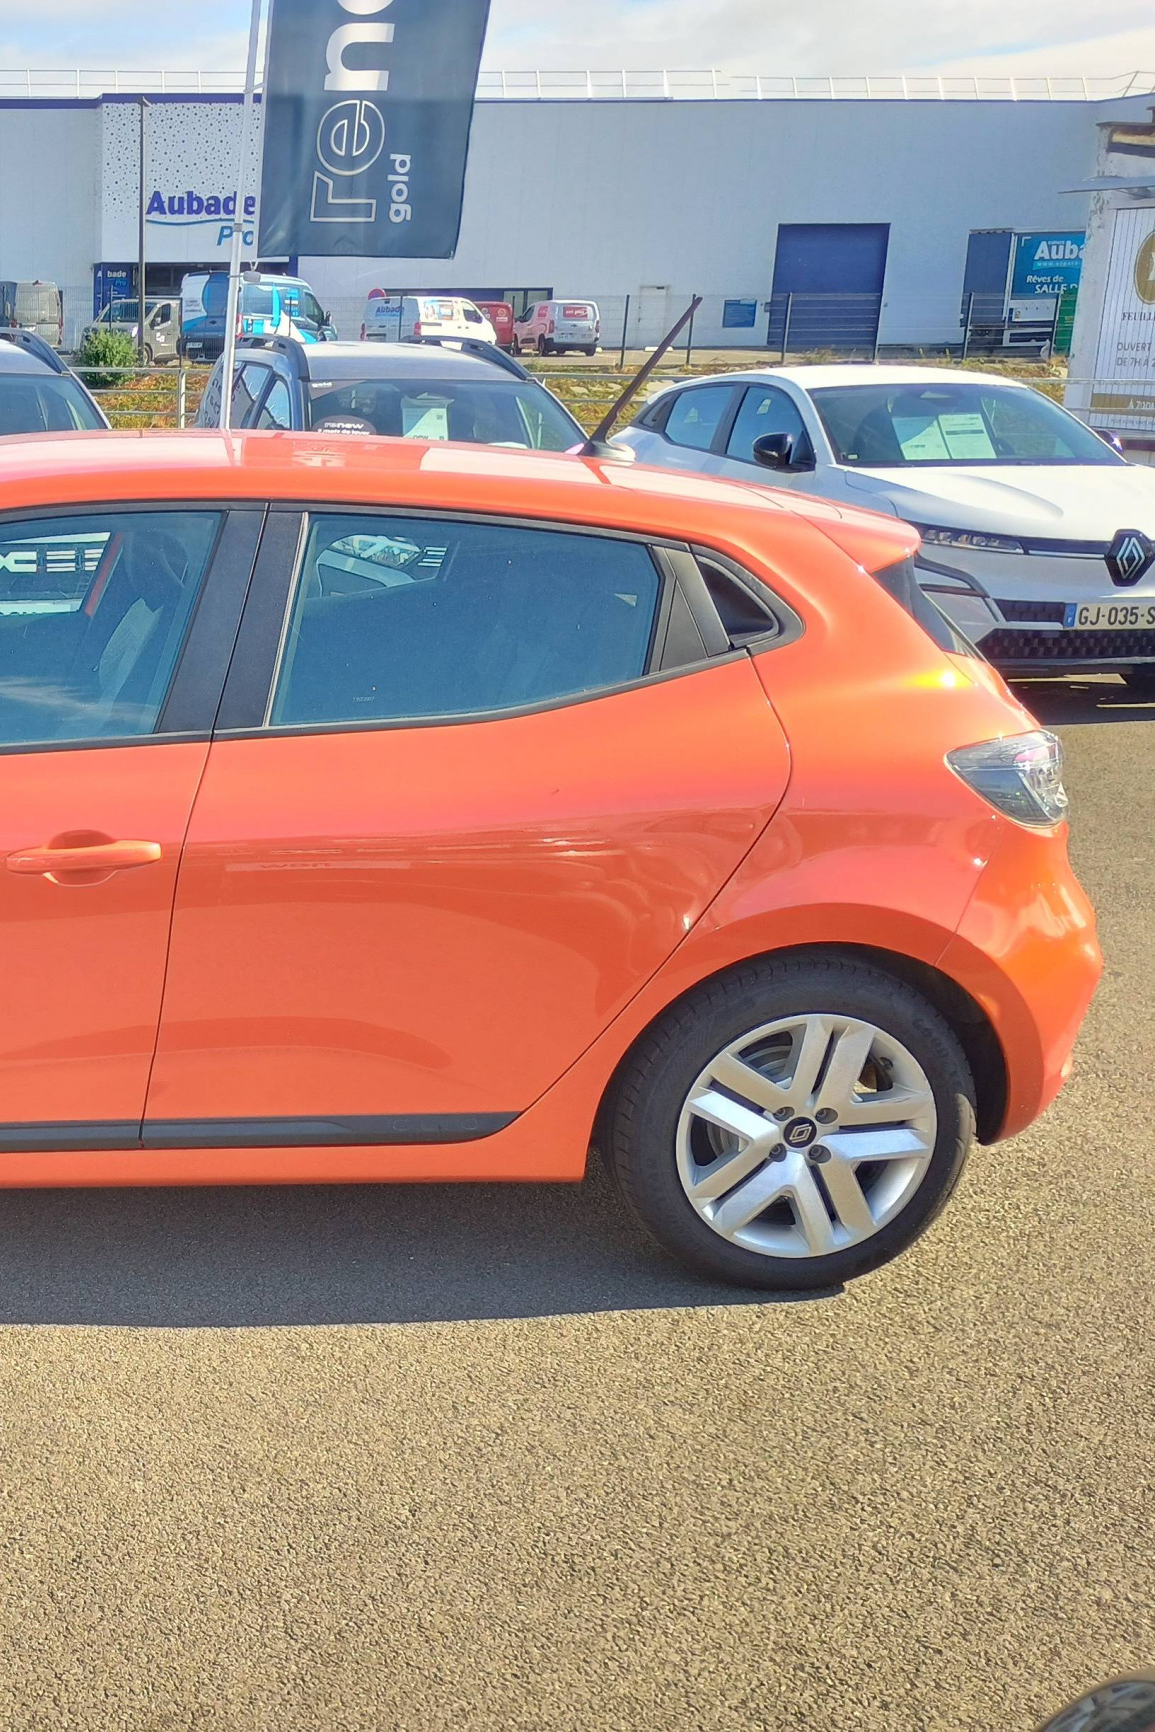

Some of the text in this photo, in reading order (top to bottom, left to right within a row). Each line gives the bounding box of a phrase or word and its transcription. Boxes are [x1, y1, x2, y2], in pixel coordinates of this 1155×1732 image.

[310, 0, 396, 223] ren
[387, 154, 412, 224] gold
[146, 190, 256, 216] Aubade
[217, 225, 254, 246] Po
[1026, 275, 1064, 283] Rêves de
[1122, 312, 1155, 321] FEUILL
[1116, 342, 1152, 352] OUVERT
[1117, 357, 1128, 366] DE
